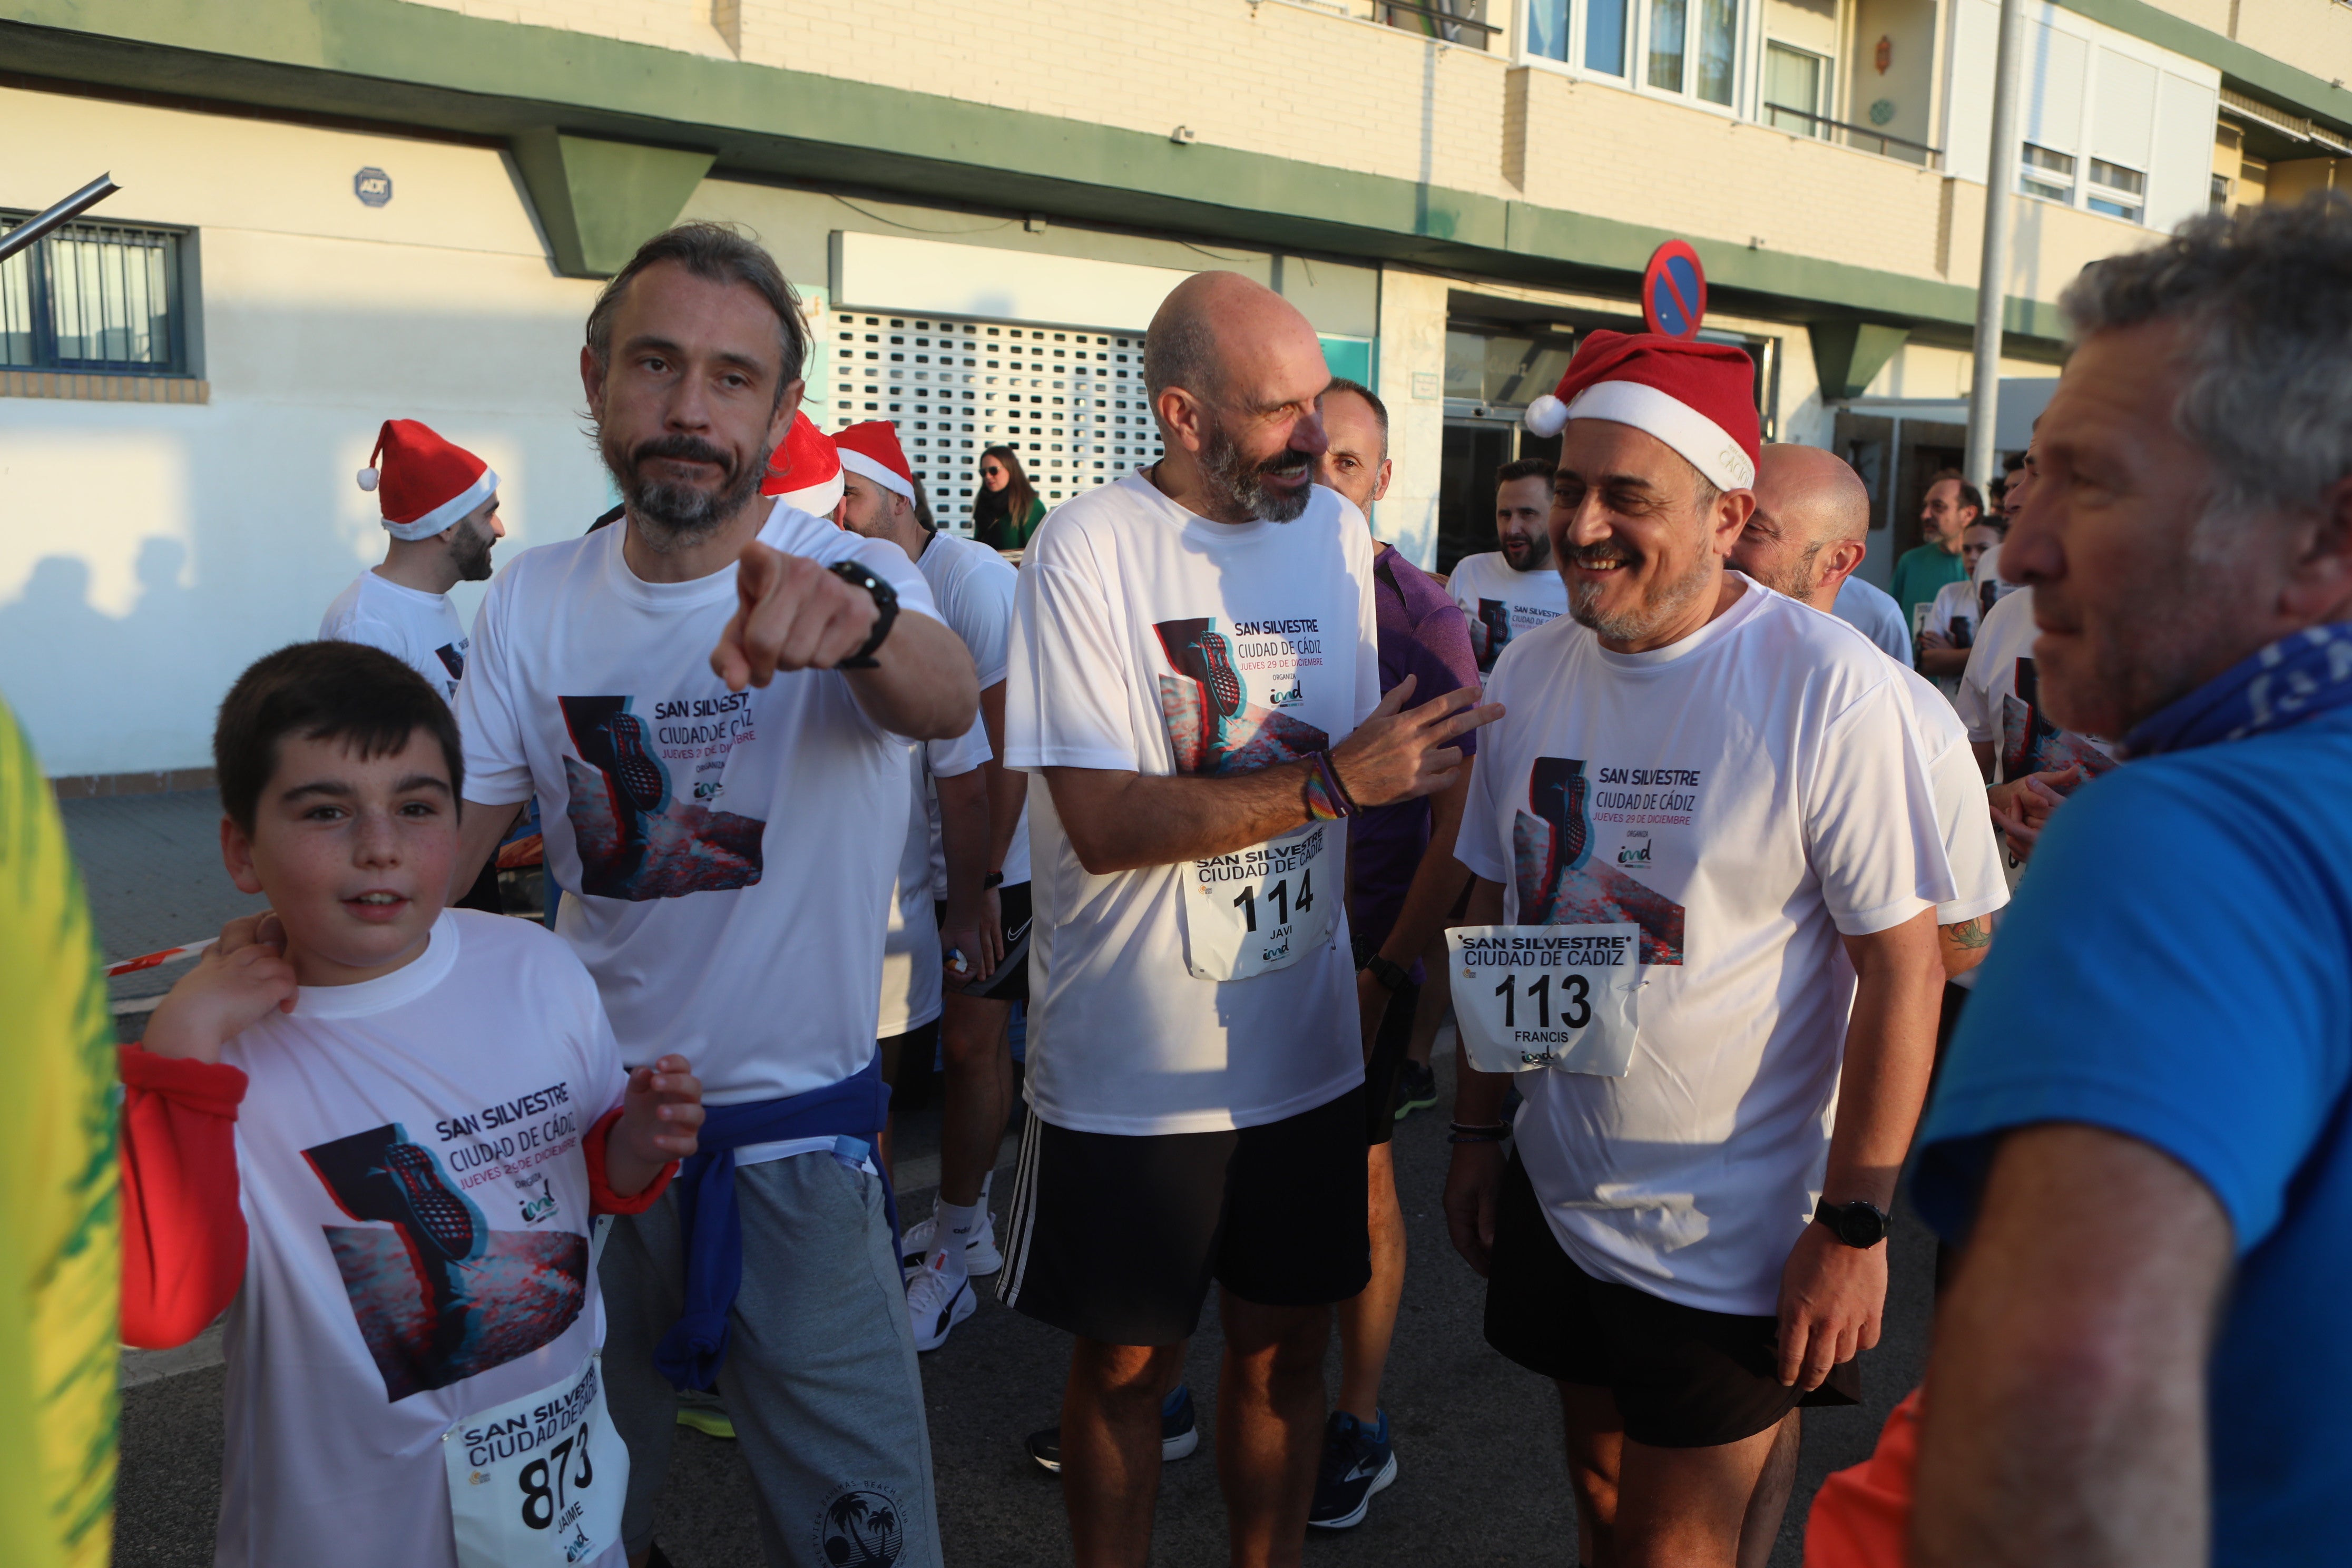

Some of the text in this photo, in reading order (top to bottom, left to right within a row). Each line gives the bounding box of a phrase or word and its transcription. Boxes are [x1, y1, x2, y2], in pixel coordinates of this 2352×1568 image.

[360, 179, 388, 194] ADT
[1234, 619, 1319, 636] SAN SILVESTRE
[1512, 614, 1534, 624] CIUDAD
[1238, 636, 1322, 659] CIUDAD DE CÁDIZ
[1240, 658, 1324, 671] JUEVES 29 DE DICIEMBRE
[1270, 680, 1303, 704] imd
[655, 701, 689, 720] SAN
[660, 726, 709, 744] CIUDAD
[662, 749, 694, 759] JUEVES
[704, 747, 717, 757] DE
[1599, 767, 1701, 787] SAN SILVESTRE
[1596, 790, 1696, 811] CIUDAD DE CÁDIZ
[1593, 811, 1691, 825] JUEVES 29 DE DICIEMBRE
[1197, 826, 1323, 868] SAN SILVESTRE
[1618, 838, 1651, 864] imd
[1199, 862, 1270, 883] CIUDAD
[1275, 857, 1296, 874] DE
[1233, 868, 1314, 933] 114
[1270, 925, 1292, 940] JAVI
[1462, 936, 1624, 950] SAN SILVESTRE
[1263, 937, 1289, 960] imd
[1464, 948, 1624, 966] CIUDAD DE CÁDIZ
[1495, 974, 1592, 1029] 113
[1515, 1031, 1569, 1042] FRANCIS
[436, 1082, 569, 1142] SAN SILVESTRE
[450, 1136, 514, 1172] CIUDAD
[518, 1126, 541, 1152] DE
[460, 1166, 502, 1190] JUEVES
[517, 1155, 532, 1170] DE
[534, 1136, 577, 1164] DICIEMBRE
[464, 1414, 527, 1447] SAN
[469, 1418, 557, 1467] CIUDAD
[562, 1403, 578, 1432] DE
[519, 1422, 593, 1530] 873
[821, 1481, 856, 1506] BAHAMAS
[864, 1481, 896, 1495] BEACH
[896, 1498, 908, 1524] CLUB
[558, 1501, 584, 1534] JAIME
